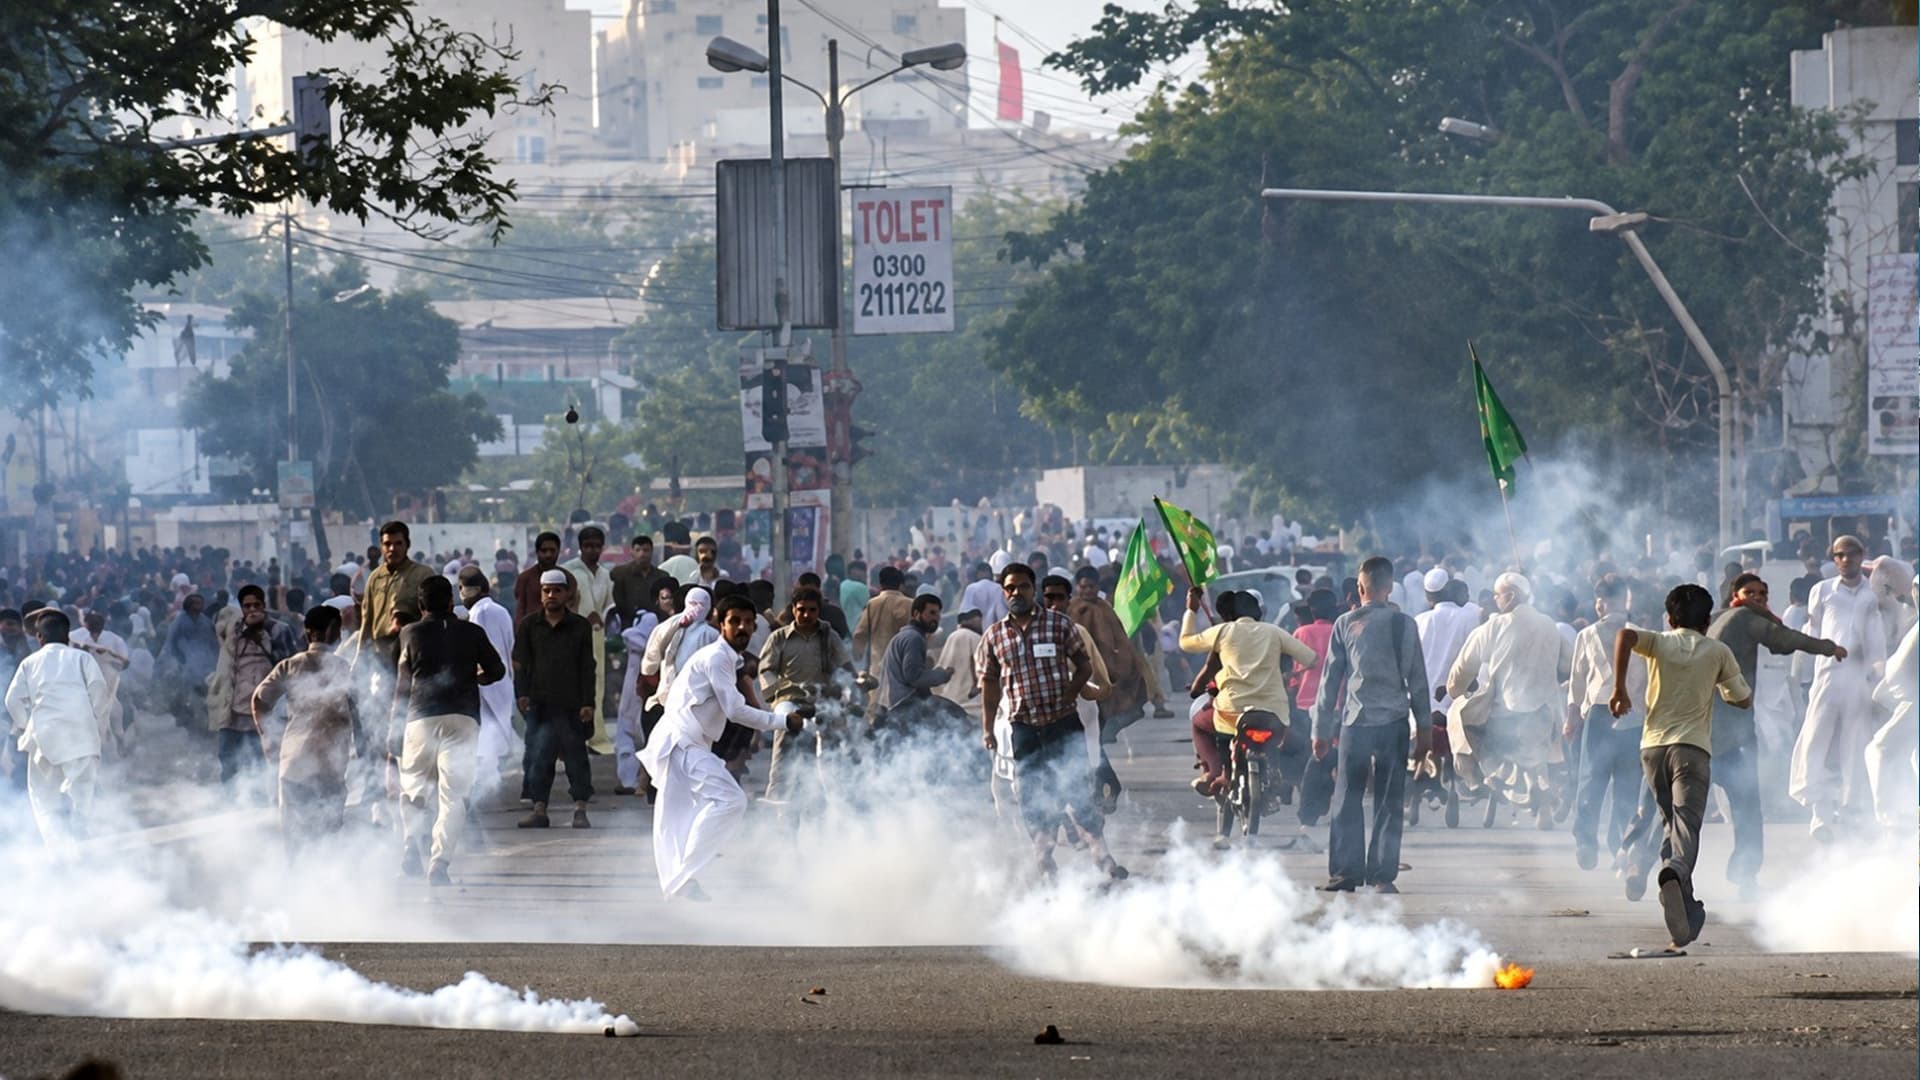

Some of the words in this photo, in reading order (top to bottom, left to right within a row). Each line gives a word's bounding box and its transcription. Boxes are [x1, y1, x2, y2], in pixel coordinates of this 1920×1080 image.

[858, 199, 944, 244] TOLET
[873, 254, 925, 277] 0300
[860, 280, 946, 316] 2111222
